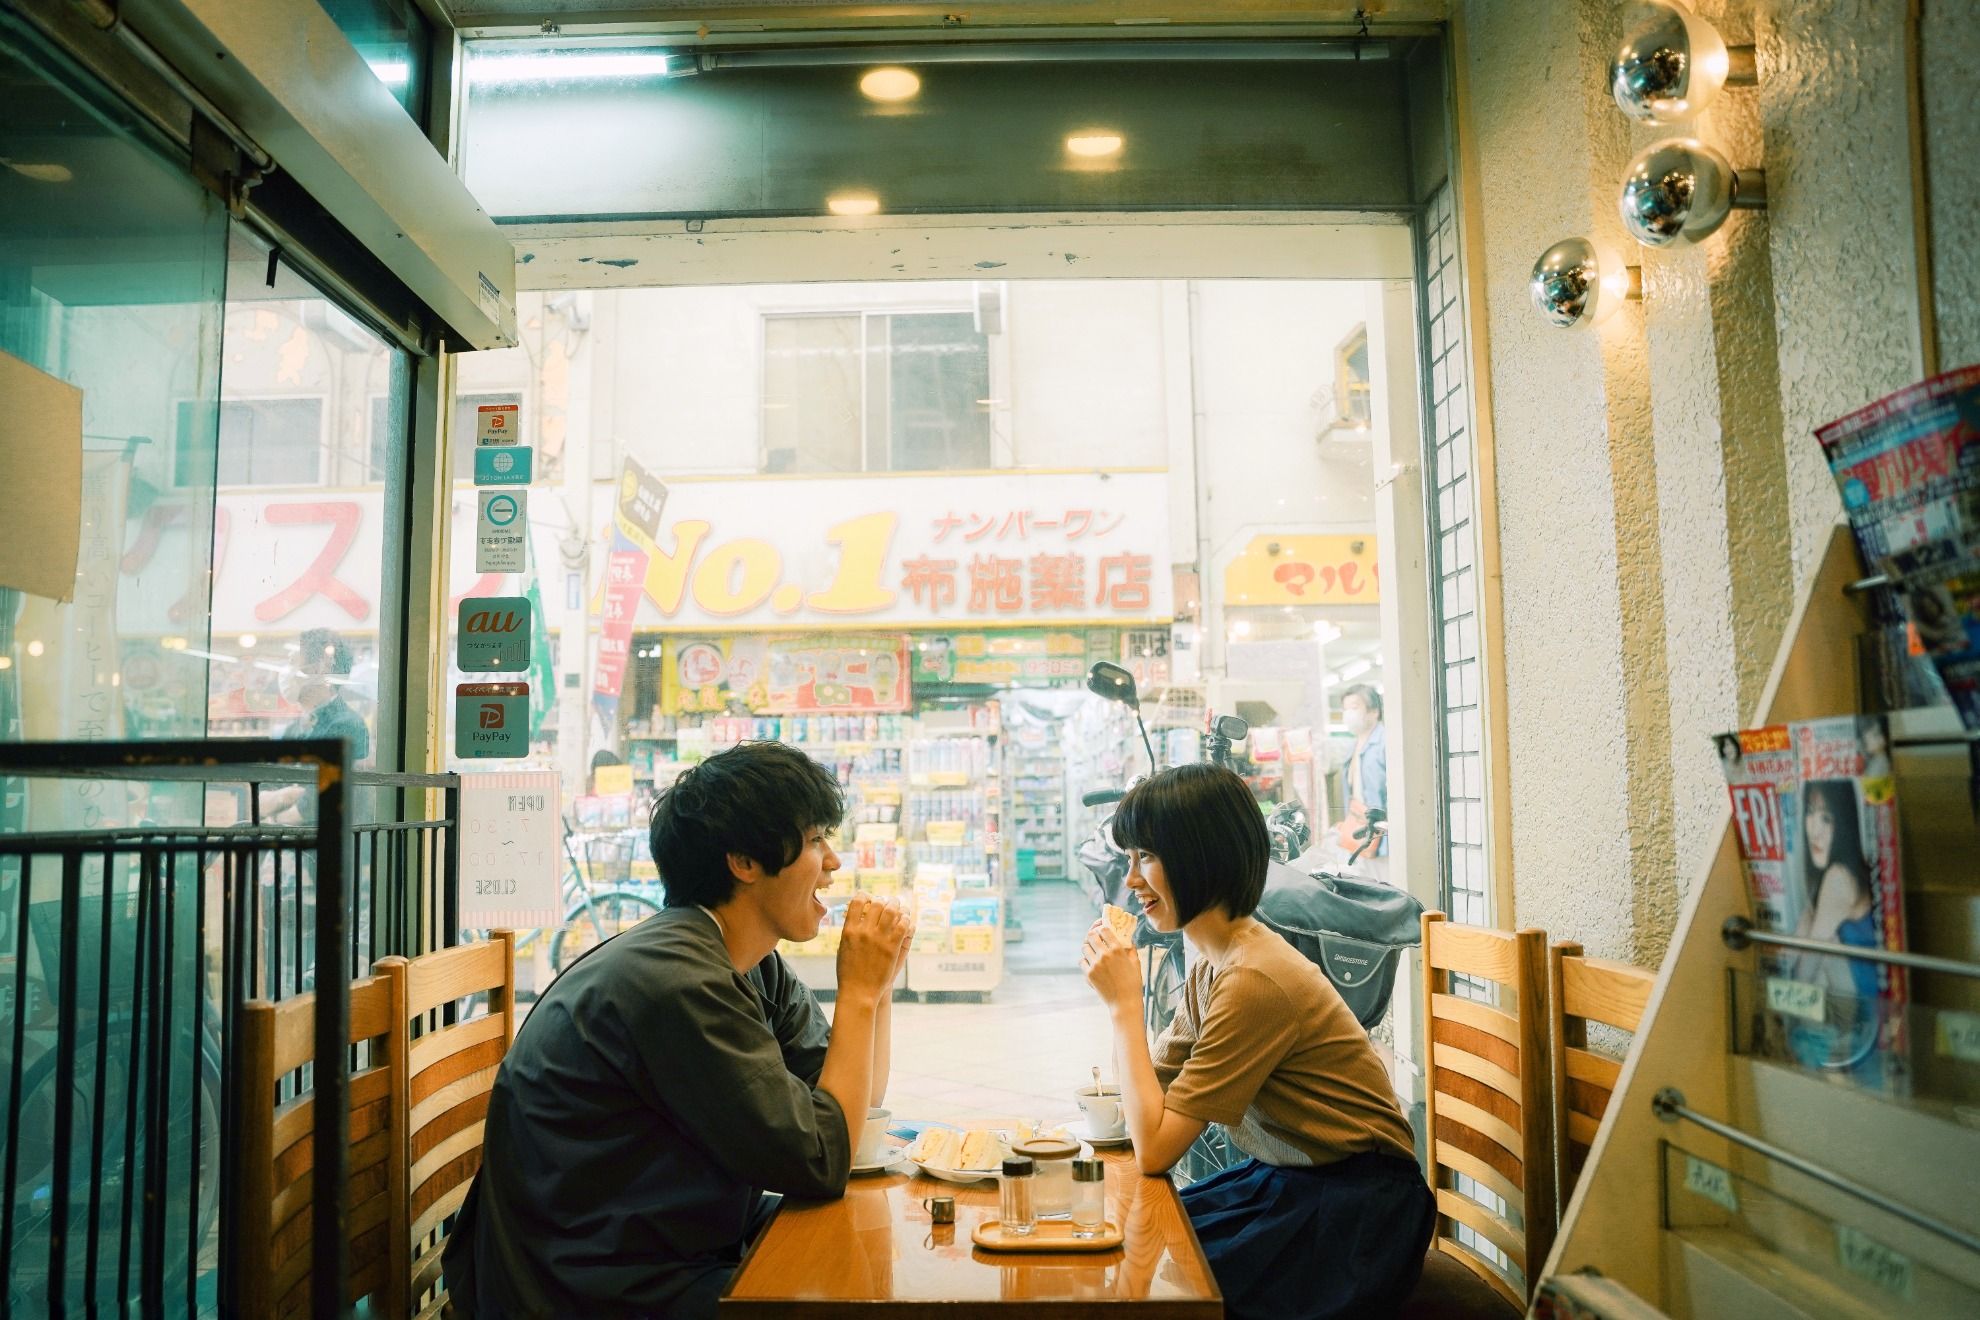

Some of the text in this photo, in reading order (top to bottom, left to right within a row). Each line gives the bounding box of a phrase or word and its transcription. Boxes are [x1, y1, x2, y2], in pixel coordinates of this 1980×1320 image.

[933, 509, 1126, 543] ナンバーワン
[901, 552, 1152, 611] 布施薬店
[466, 610, 523, 633] au
[472, 731, 512, 743] PayPay
